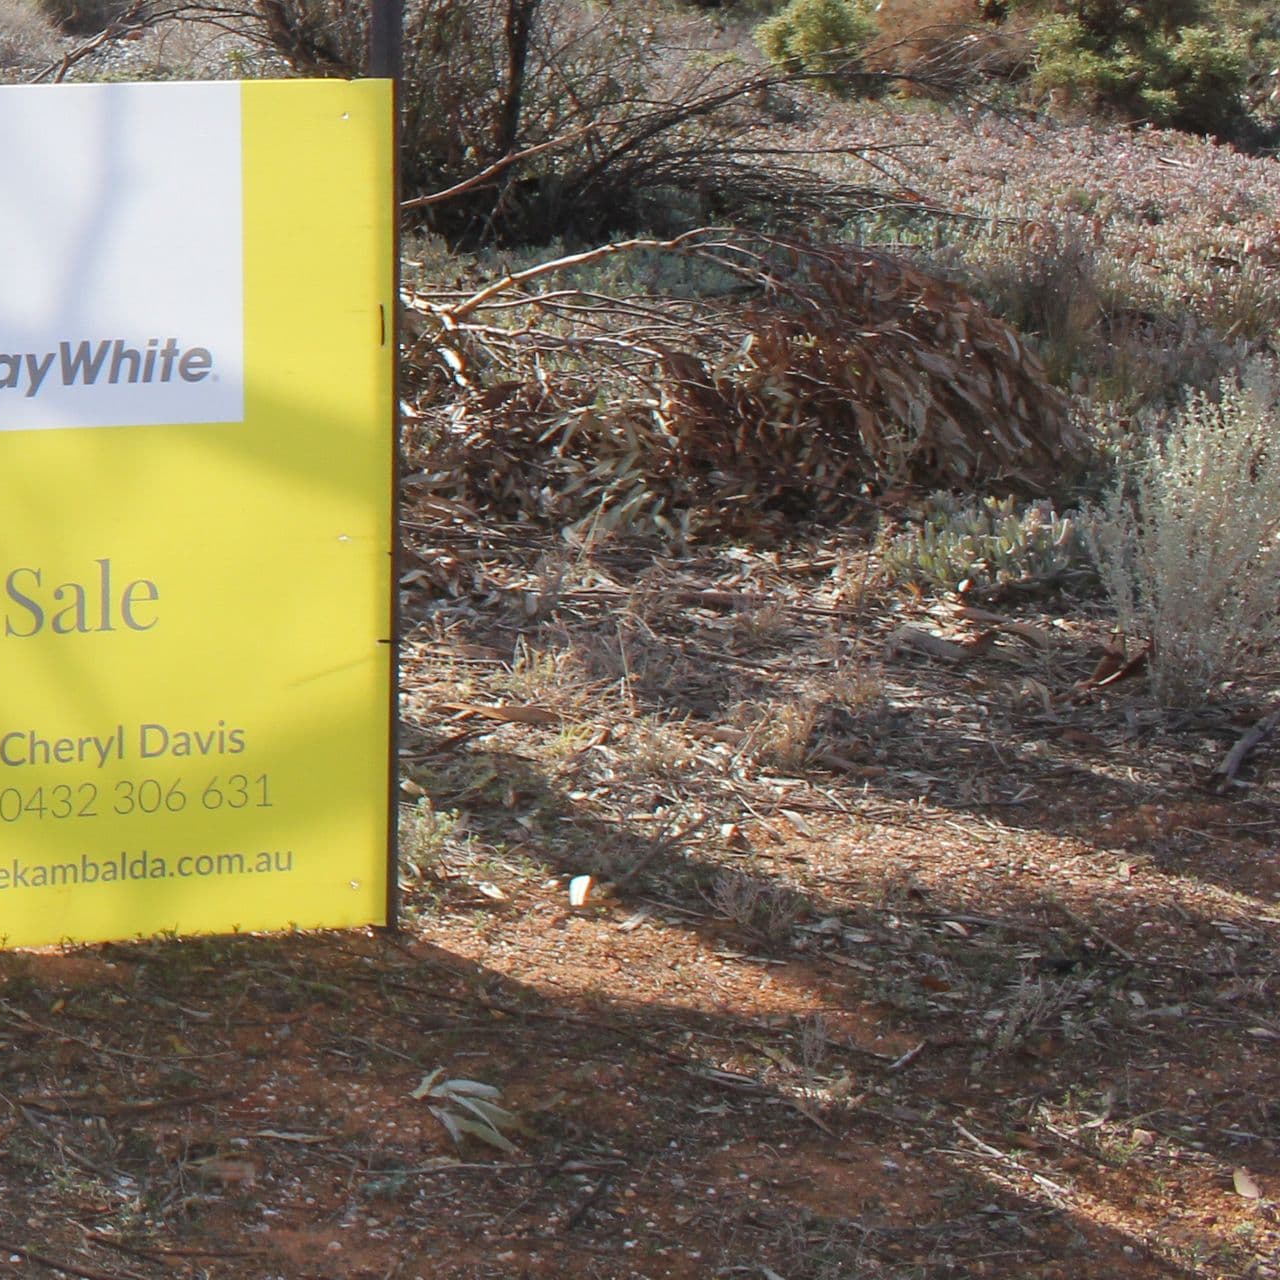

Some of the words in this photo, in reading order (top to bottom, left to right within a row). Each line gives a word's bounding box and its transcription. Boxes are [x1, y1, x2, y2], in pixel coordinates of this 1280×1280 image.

[5, 558, 159, 637] Sale
[0, 725, 124, 768] Cheryl
[140, 720, 245, 758] Davis
[0, 783, 97, 822] 0432
[113, 778, 186, 815] 306
[202, 773, 273, 809] 631
